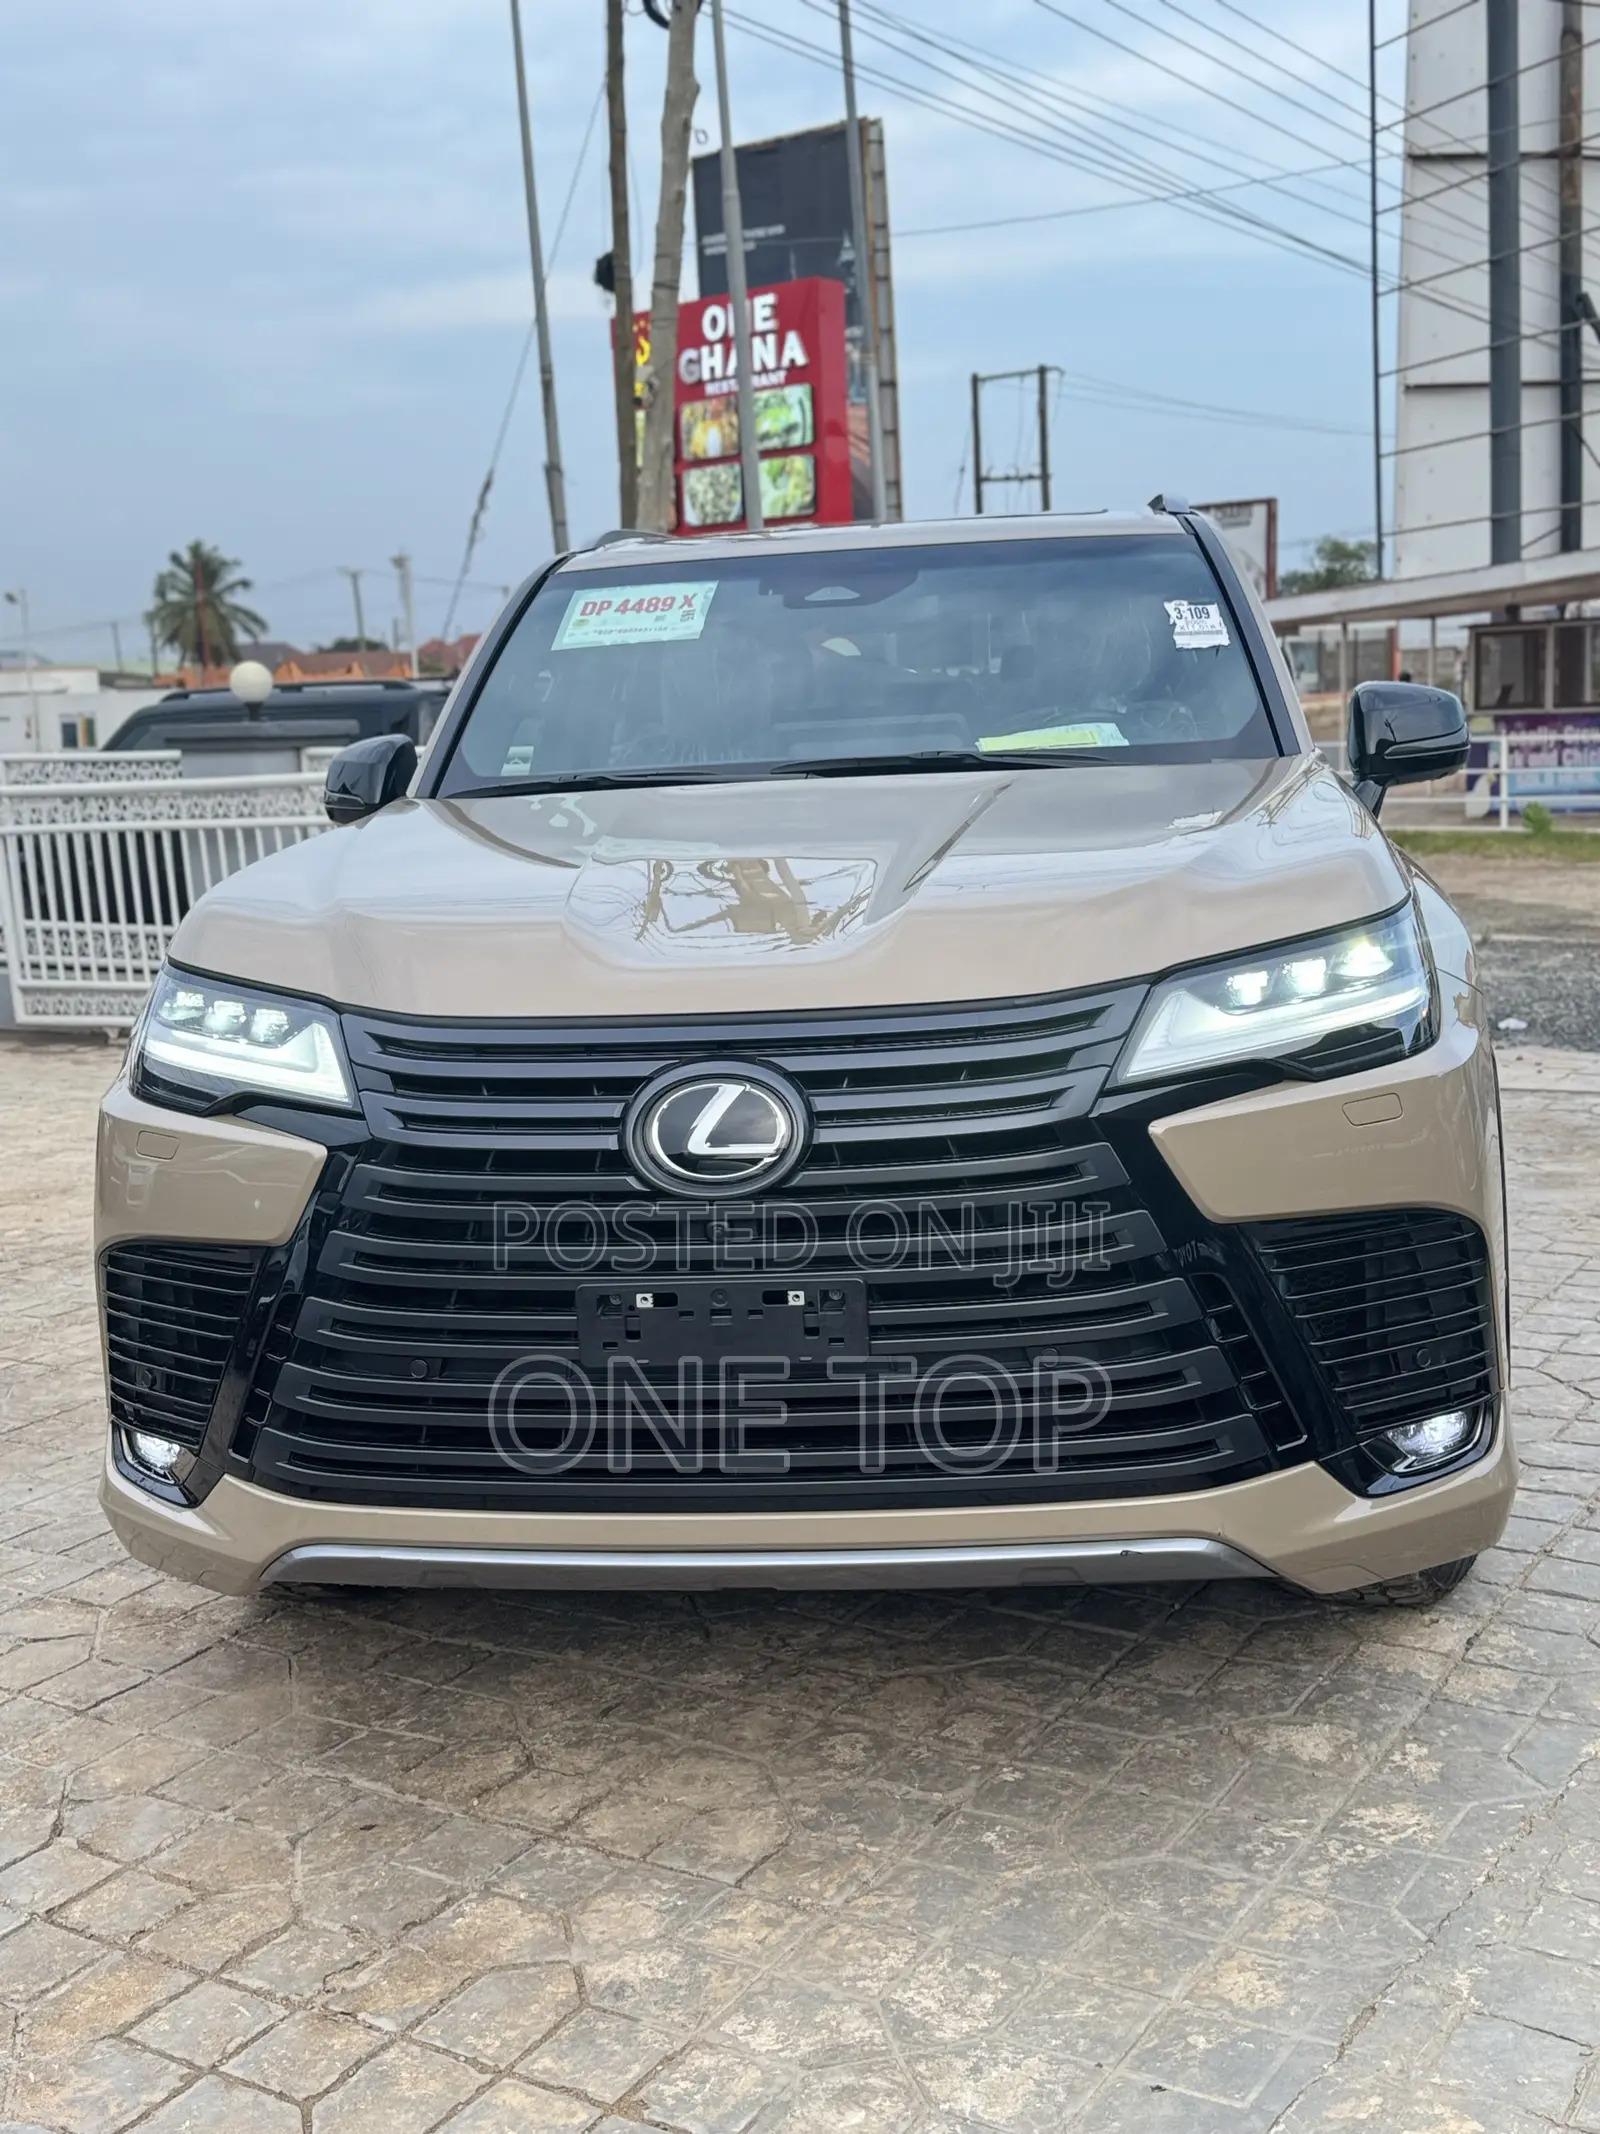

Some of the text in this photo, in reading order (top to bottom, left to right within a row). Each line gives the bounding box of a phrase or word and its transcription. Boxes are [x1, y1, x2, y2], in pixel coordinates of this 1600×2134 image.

[704, 370, 787, 397] RESTRANT
[580, 593, 698, 617] DP 4489 X
